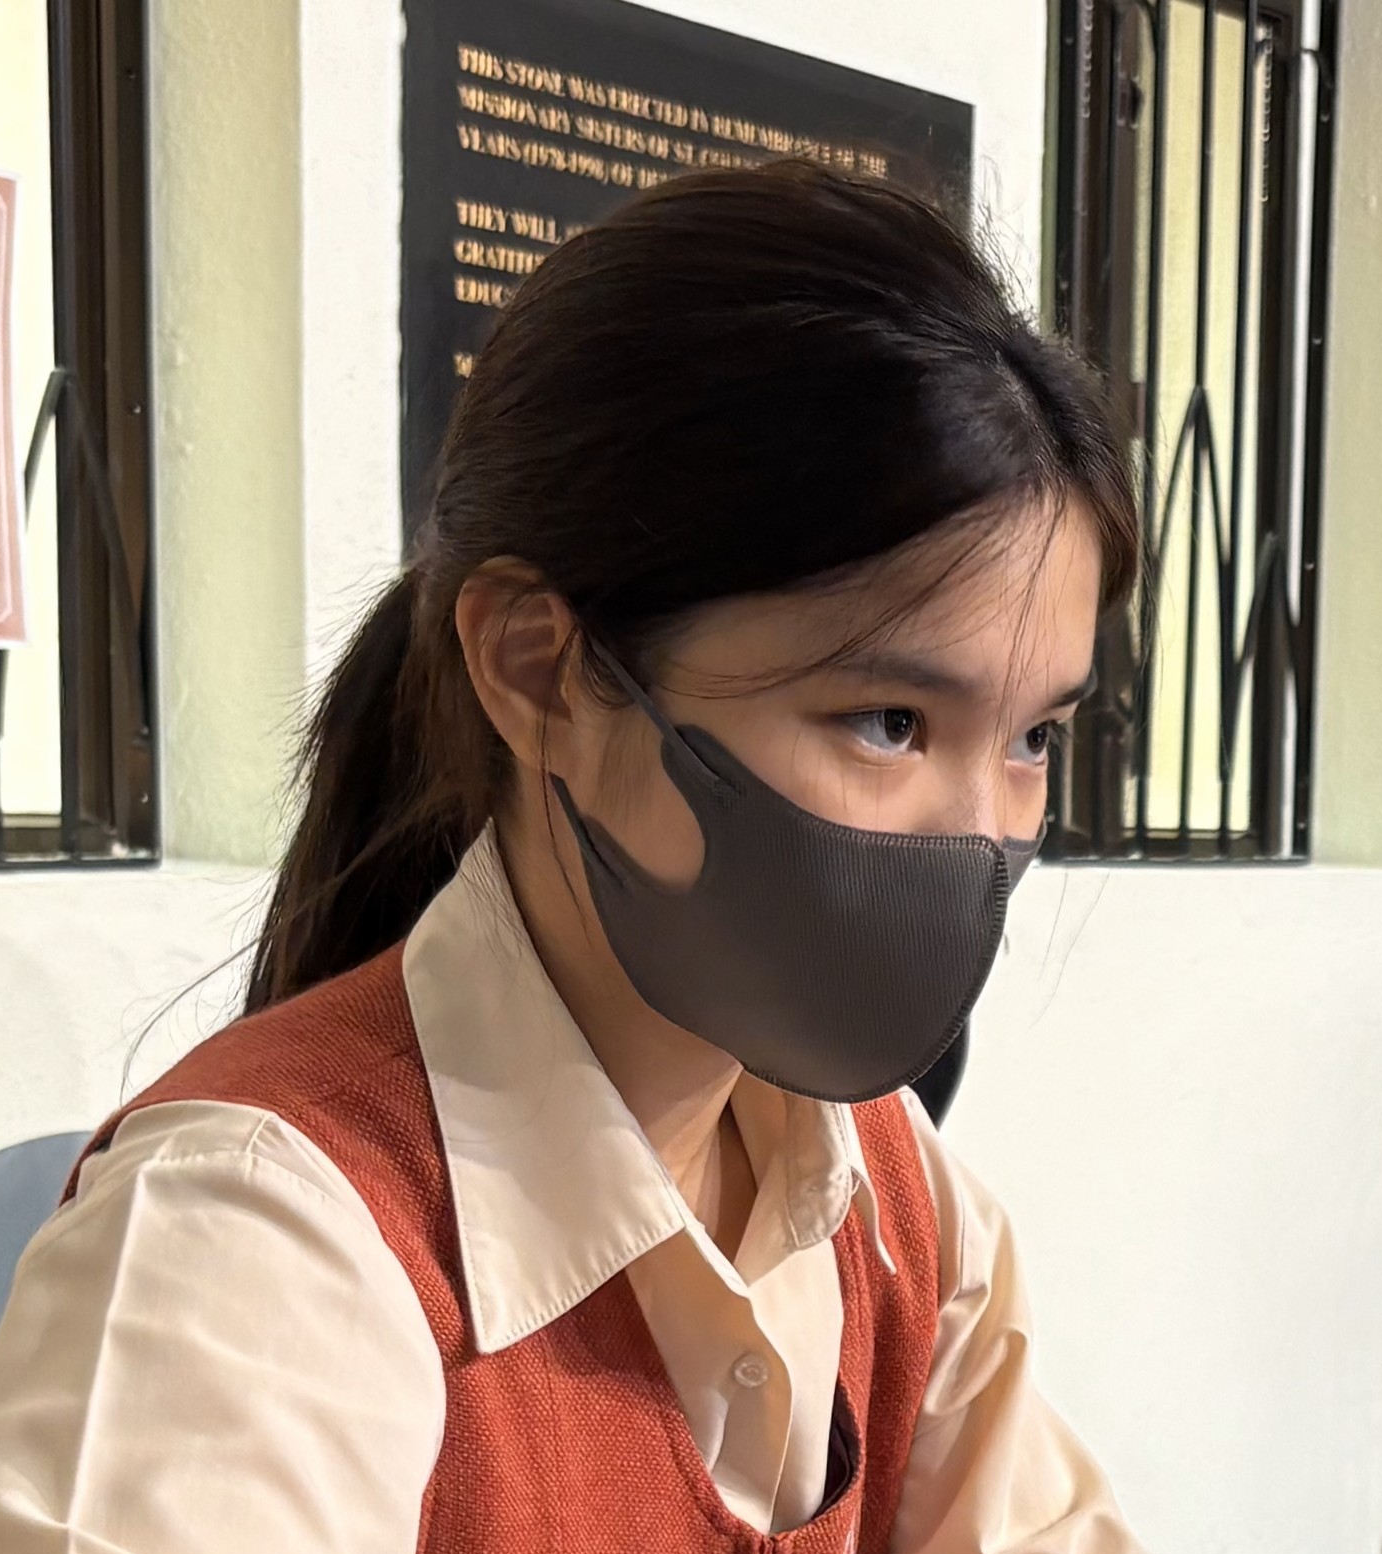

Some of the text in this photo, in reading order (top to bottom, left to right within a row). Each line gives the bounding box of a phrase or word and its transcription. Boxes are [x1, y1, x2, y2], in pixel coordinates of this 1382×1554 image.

[458, 43, 503, 81] THIS
[505, 57, 566, 97] STONE
[568, 72, 607, 107] WAS
[608, 83, 688, 127] ERECTED
[457, 121, 522, 161] YEARS
[573, 114, 646, 154] SISTERS
[456, 199, 506, 233] THEY
[510, 208, 562, 245] WILL
